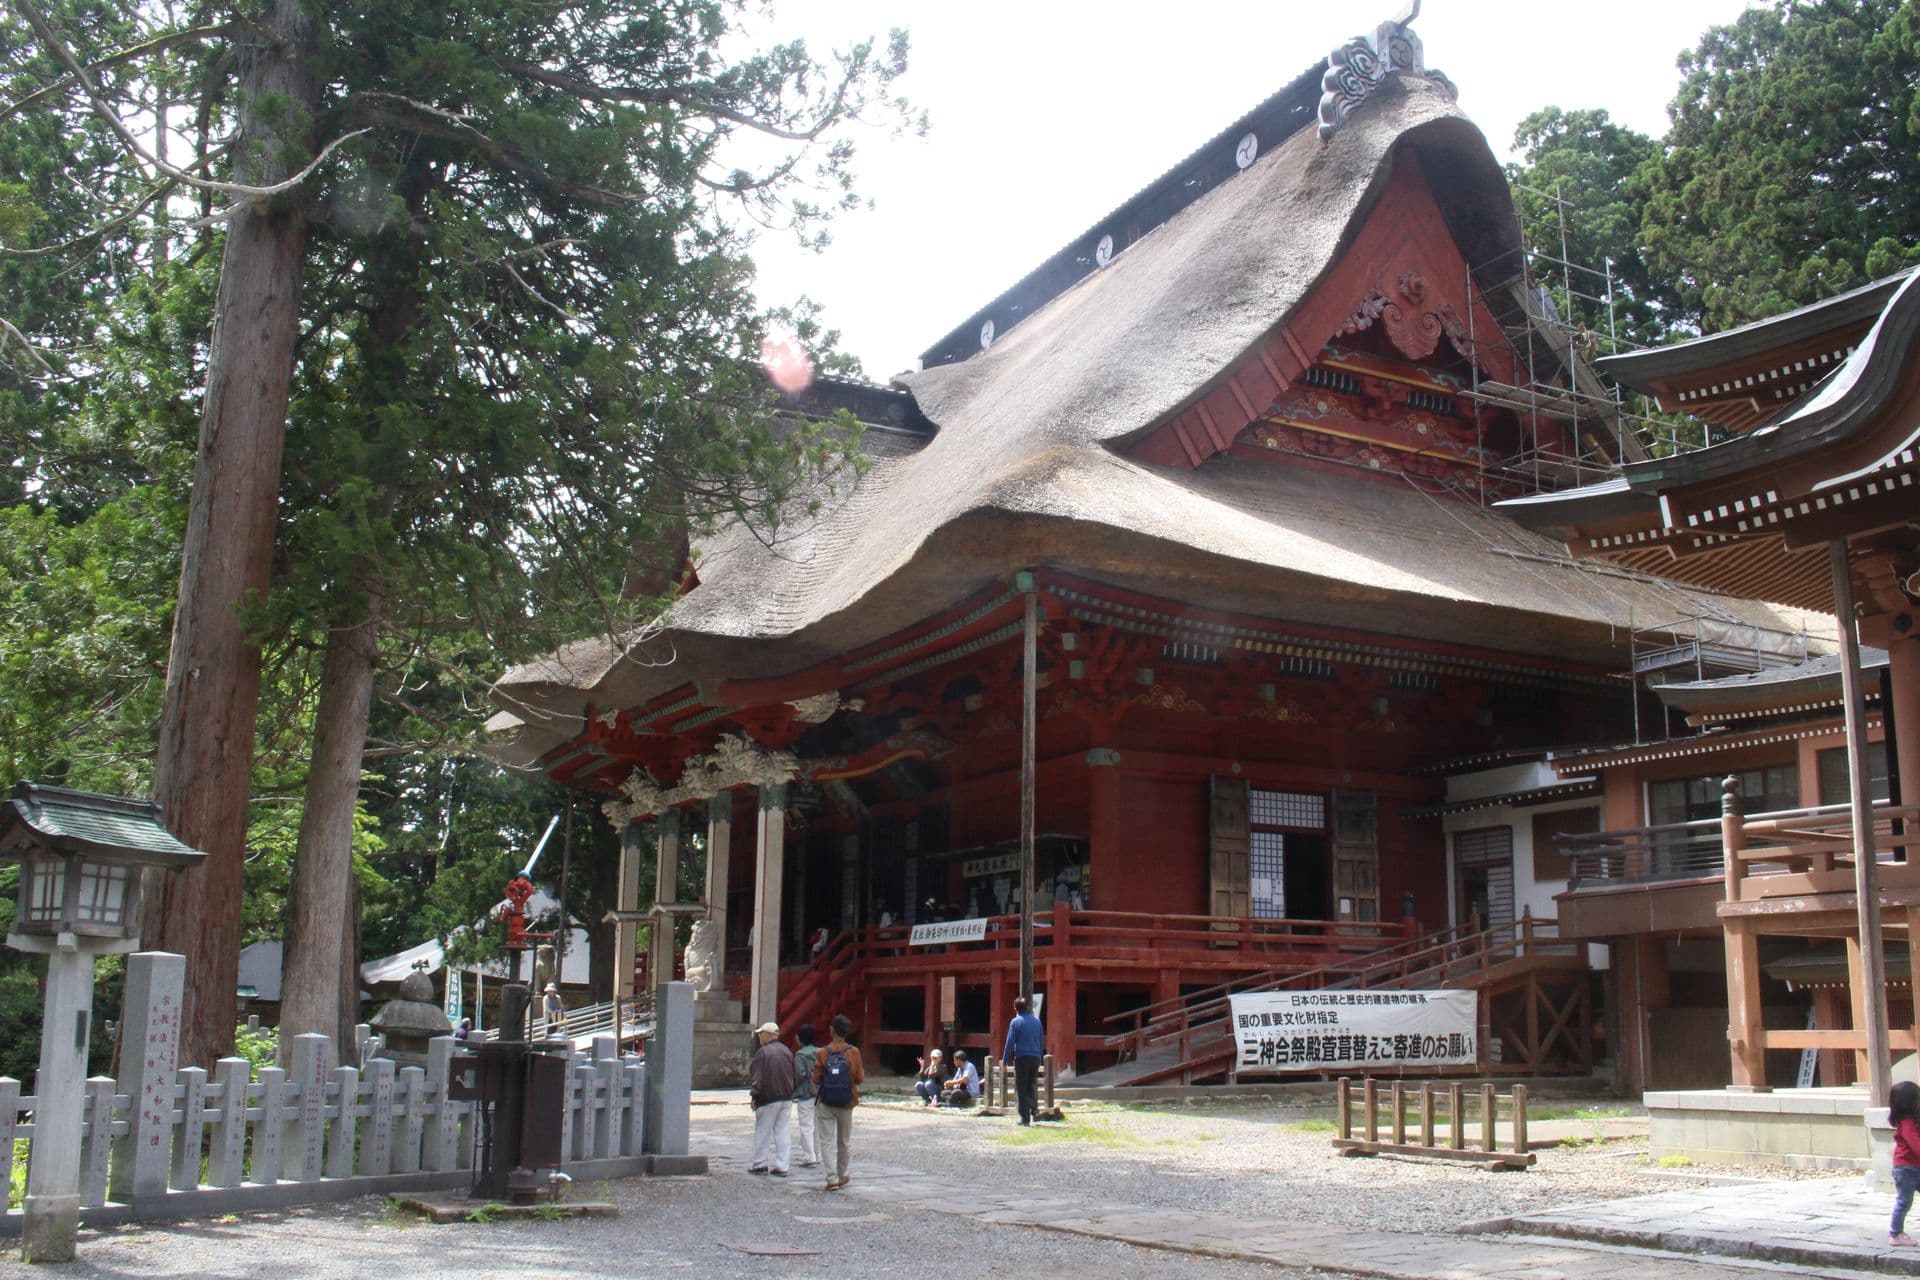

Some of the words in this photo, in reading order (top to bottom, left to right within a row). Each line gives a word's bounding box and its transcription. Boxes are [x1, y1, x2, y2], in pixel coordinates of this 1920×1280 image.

[1238, 1011, 1339, 1028] 国の重要文化財指定
